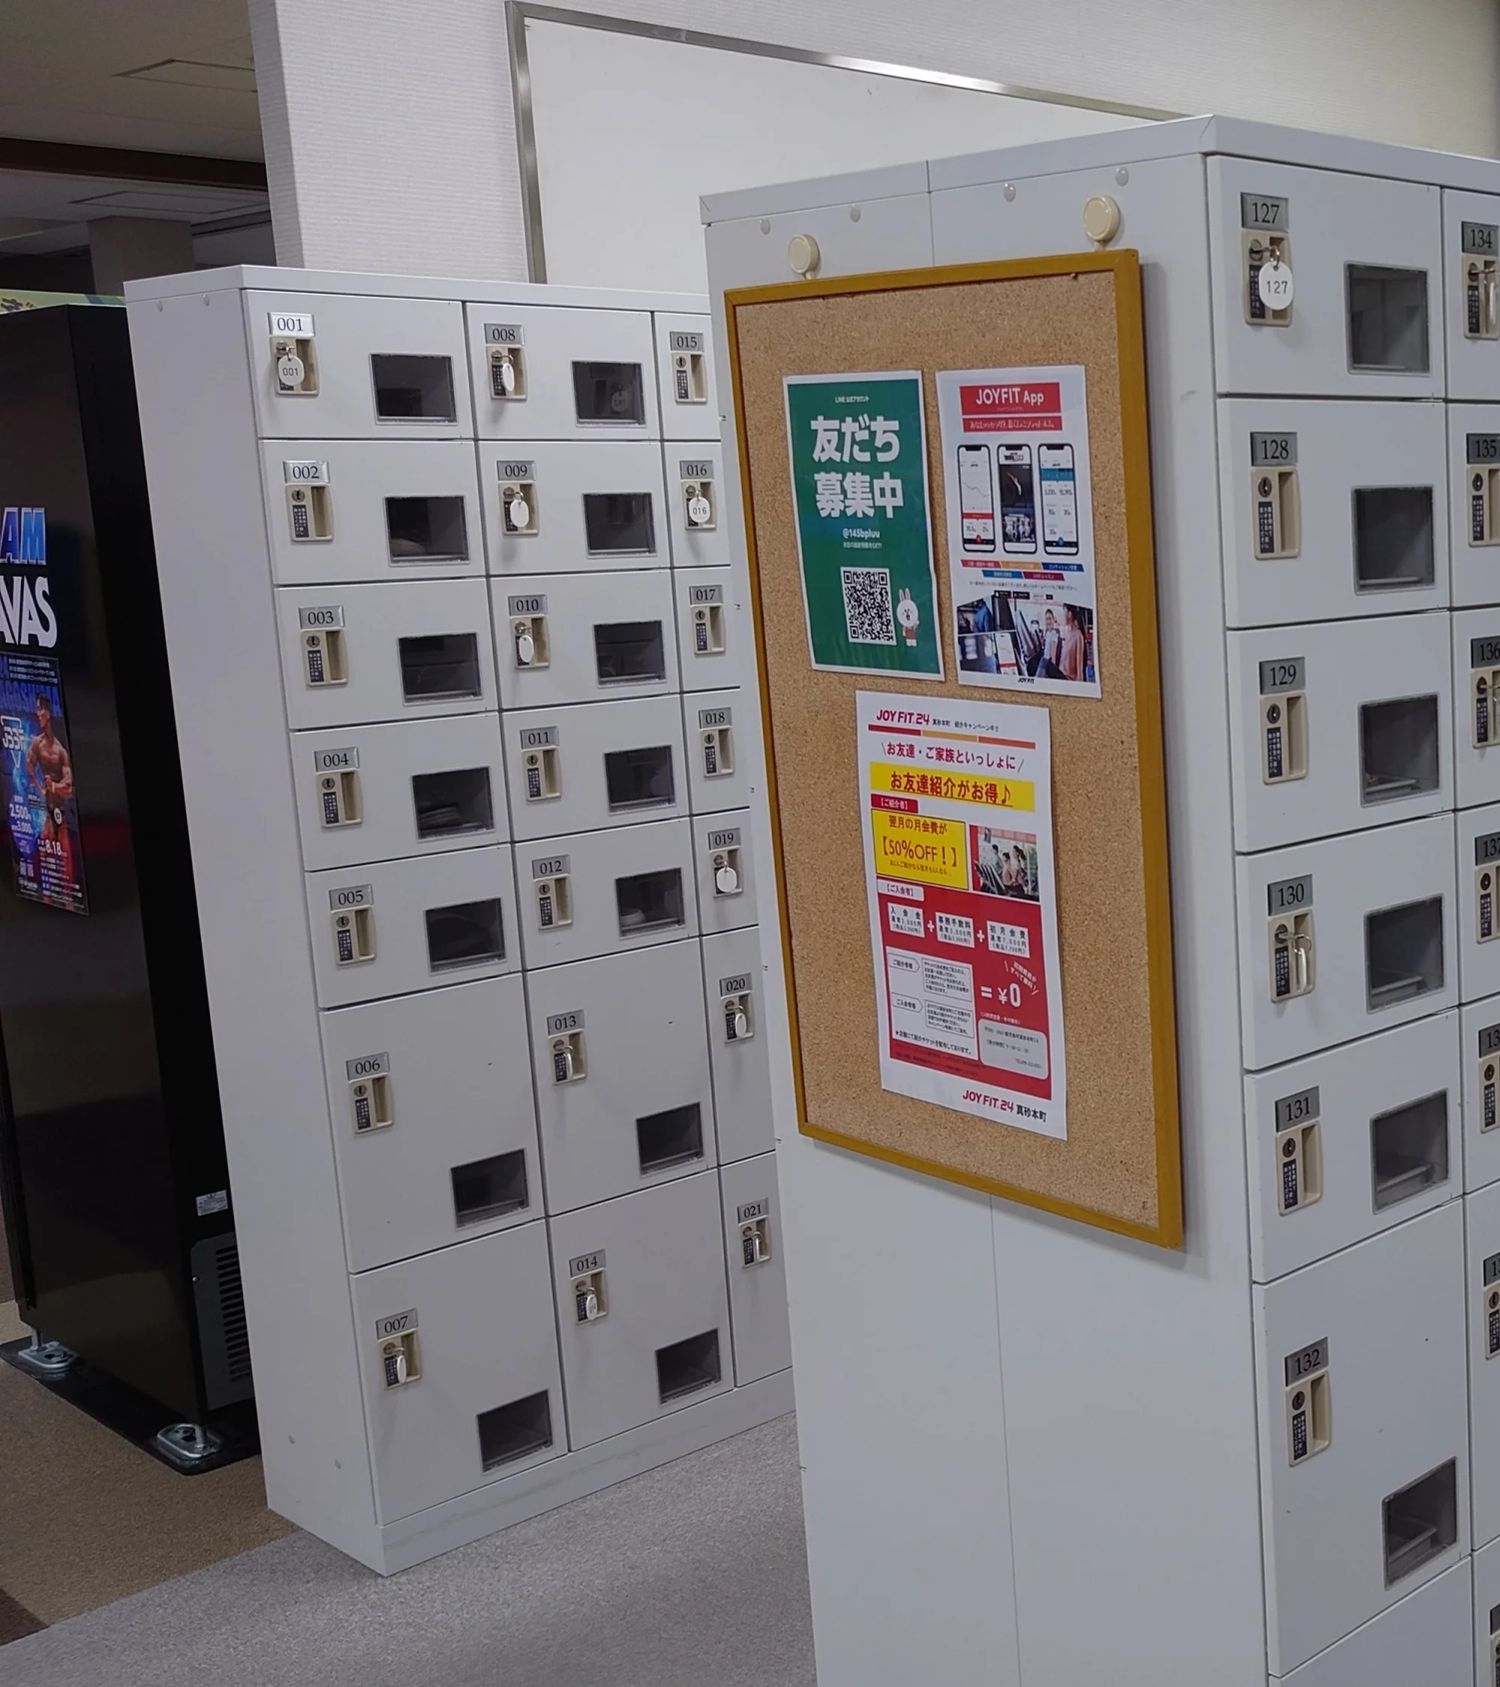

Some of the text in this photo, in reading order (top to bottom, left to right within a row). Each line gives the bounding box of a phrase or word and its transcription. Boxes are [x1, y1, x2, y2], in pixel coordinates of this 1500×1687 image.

[1251, 202, 1280, 224] 127
[1470, 229, 1493, 249] 134
[1266, 280, 1288, 295] 127
[277, 317, 304, 331] 001
[492, 328, 515, 341] 008
[677, 336, 697, 348] 015
[282, 367, 299, 377] 001
[975, 388, 1044, 406] JOYFIT App
[810, 413, 900, 463] 友だち
[1261, 438, 1290, 460] 128
[1475, 439, 1497, 458] 135
[292, 465, 319, 479] 002
[504, 465, 528, 477] 009
[686, 464, 707, 476] 016
[814, 471, 904, 519] 募集中
[693, 507, 707, 515] 016
[696, 589, 716, 600] 017
[515, 599, 539, 612] 010
[307, 611, 334, 625] 003
[1480, 643, 1500, 661] 136
[1269, 664, 1297, 686] 129
[705, 712, 726, 724] 018
[528, 731, 549, 745] 011
[323, 753, 349, 767] 004
[715, 832, 734, 845] 019
[539, 860, 563, 874] 012
[337, 889, 364, 904] 005
[1278, 883, 1305, 907] 130
[726, 977, 745, 991] 020
[554, 1015, 577, 1030] 013
[354, 1058, 381, 1075] 006
[1286, 1096, 1311, 1122] 131
[743, 1204, 762, 1219] 021
[576, 1256, 598, 1273] 014
[384, 1315, 409, 1333] 007
[1294, 1350, 1321, 1375] 132
